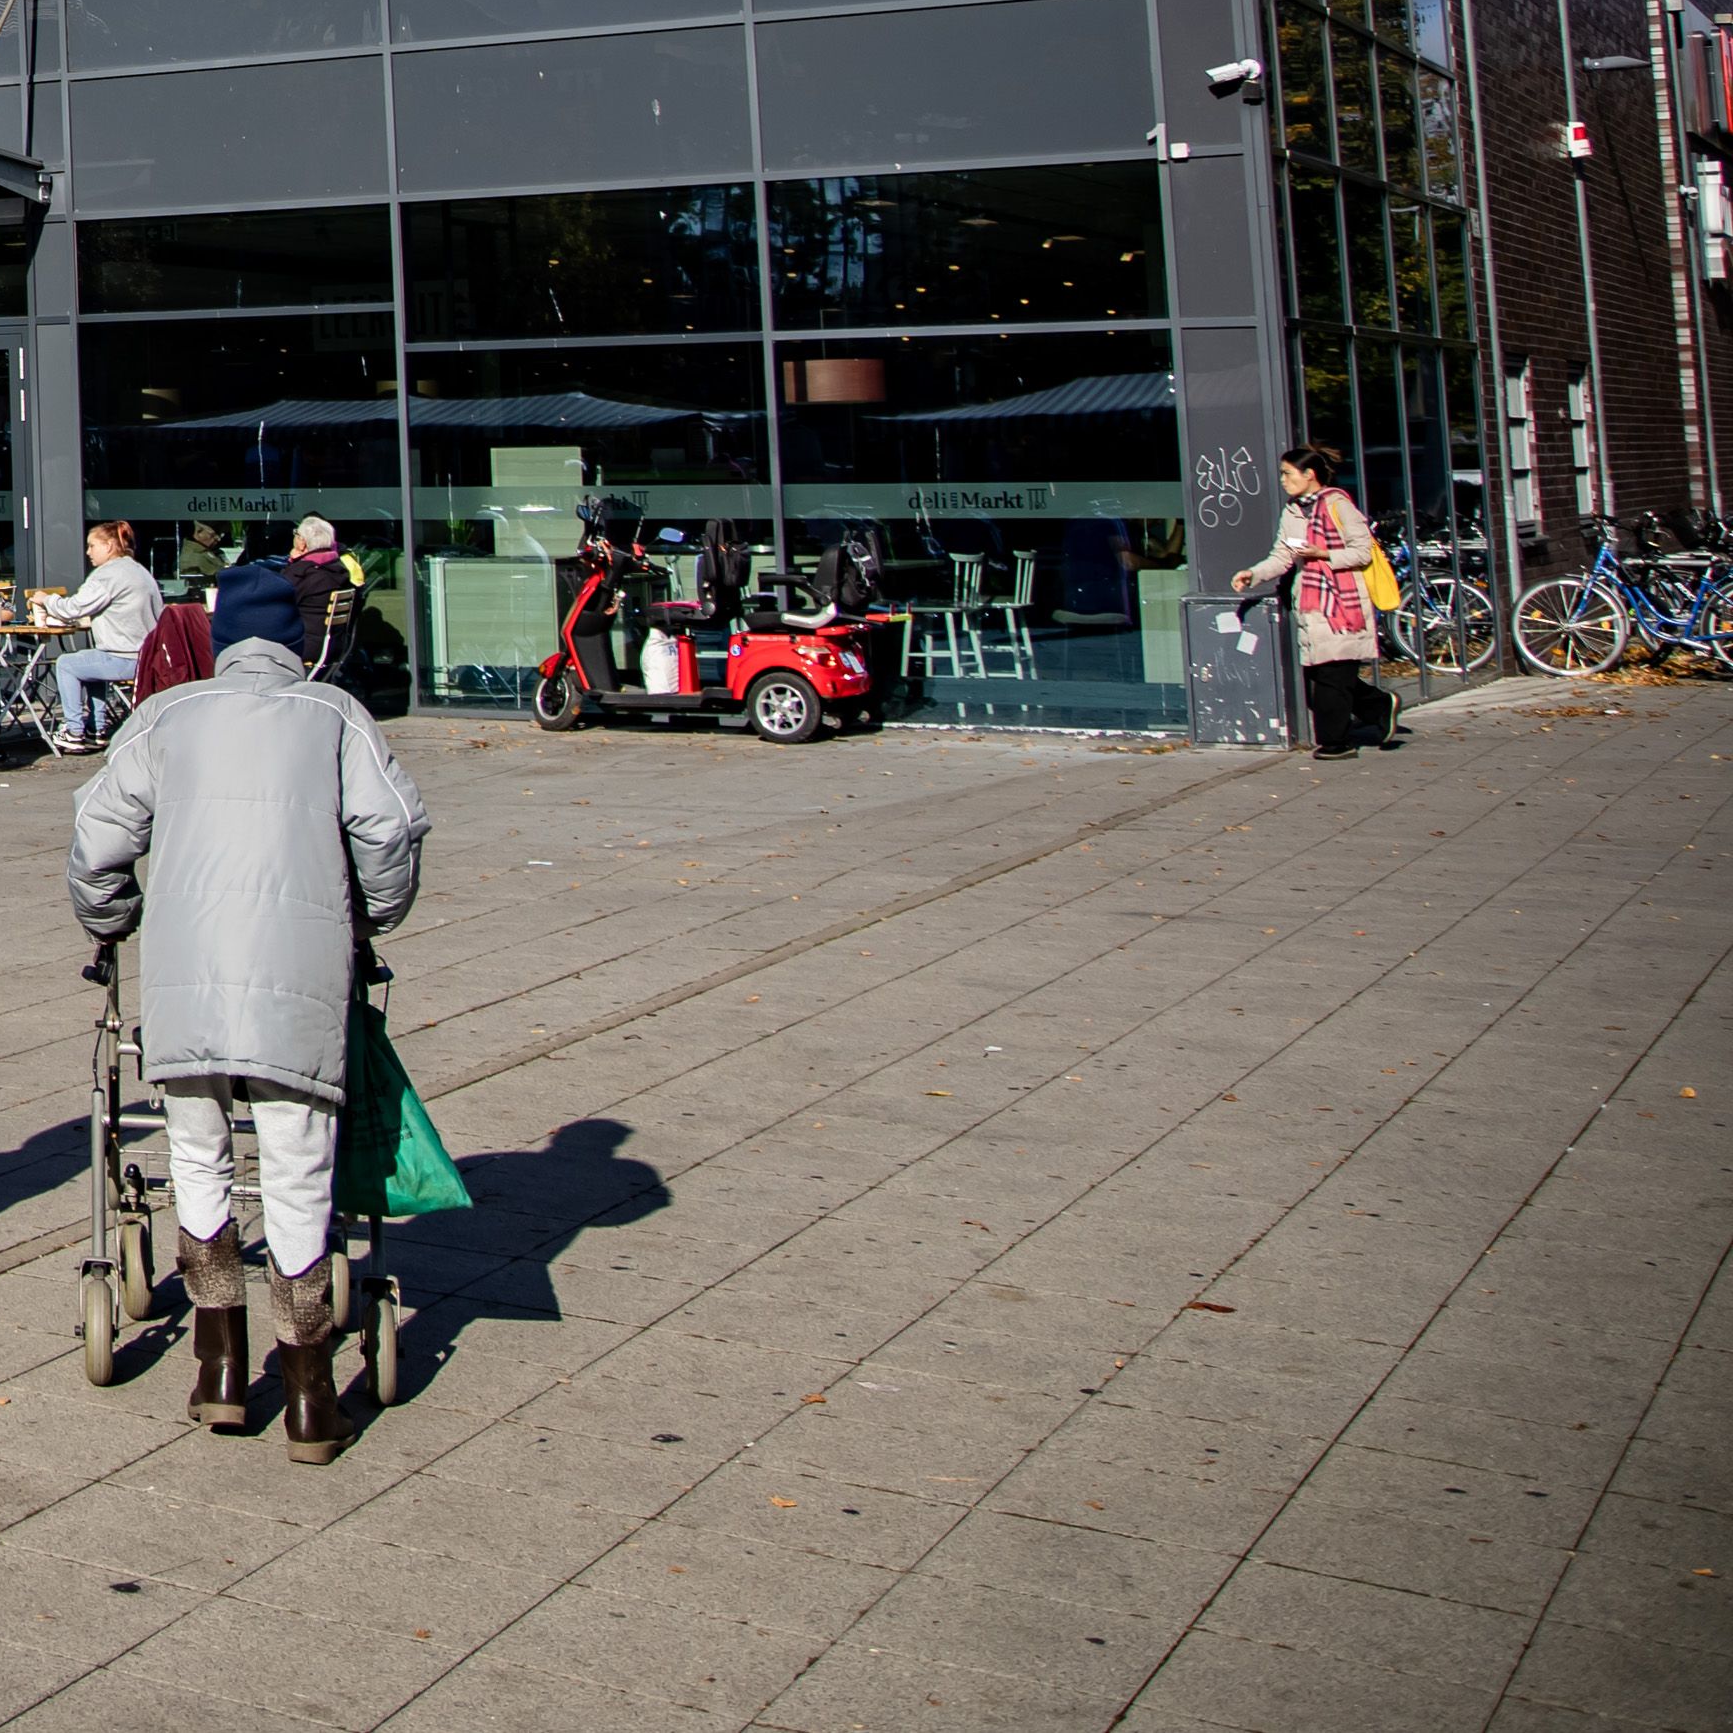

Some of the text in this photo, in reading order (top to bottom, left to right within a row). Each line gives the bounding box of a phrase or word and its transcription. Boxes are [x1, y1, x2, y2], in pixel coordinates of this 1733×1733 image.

[187, 496, 218, 513] deli
[228, 496, 278, 513] Markt
[908, 491, 947, 509] deli
[960, 491, 1024, 509] Markt
[1198, 492, 1244, 529] 69
